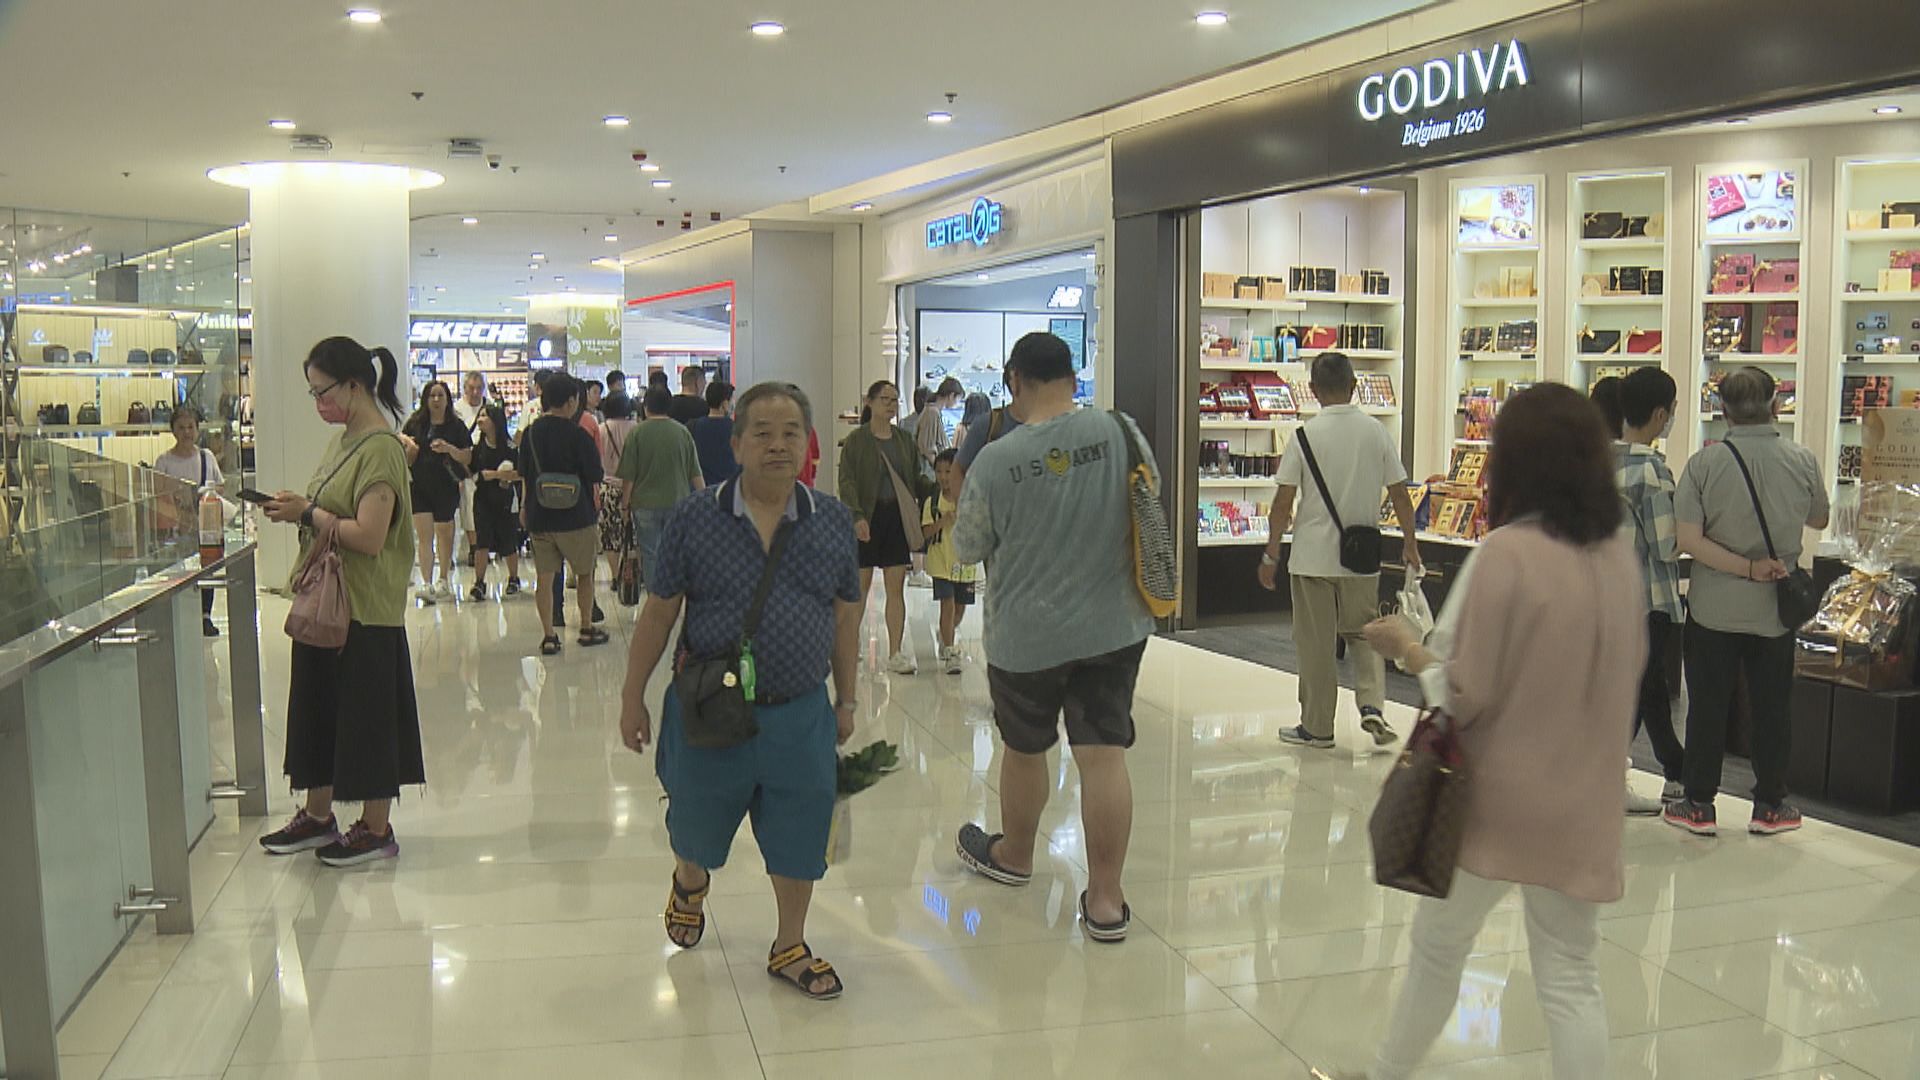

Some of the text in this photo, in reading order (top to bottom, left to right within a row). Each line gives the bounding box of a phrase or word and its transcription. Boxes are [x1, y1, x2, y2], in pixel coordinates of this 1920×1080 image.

[1357, 37, 1528, 121] GODIVA
[1401, 106, 1486, 148] Belgium 1926
[409, 321, 528, 343] SKECHE
